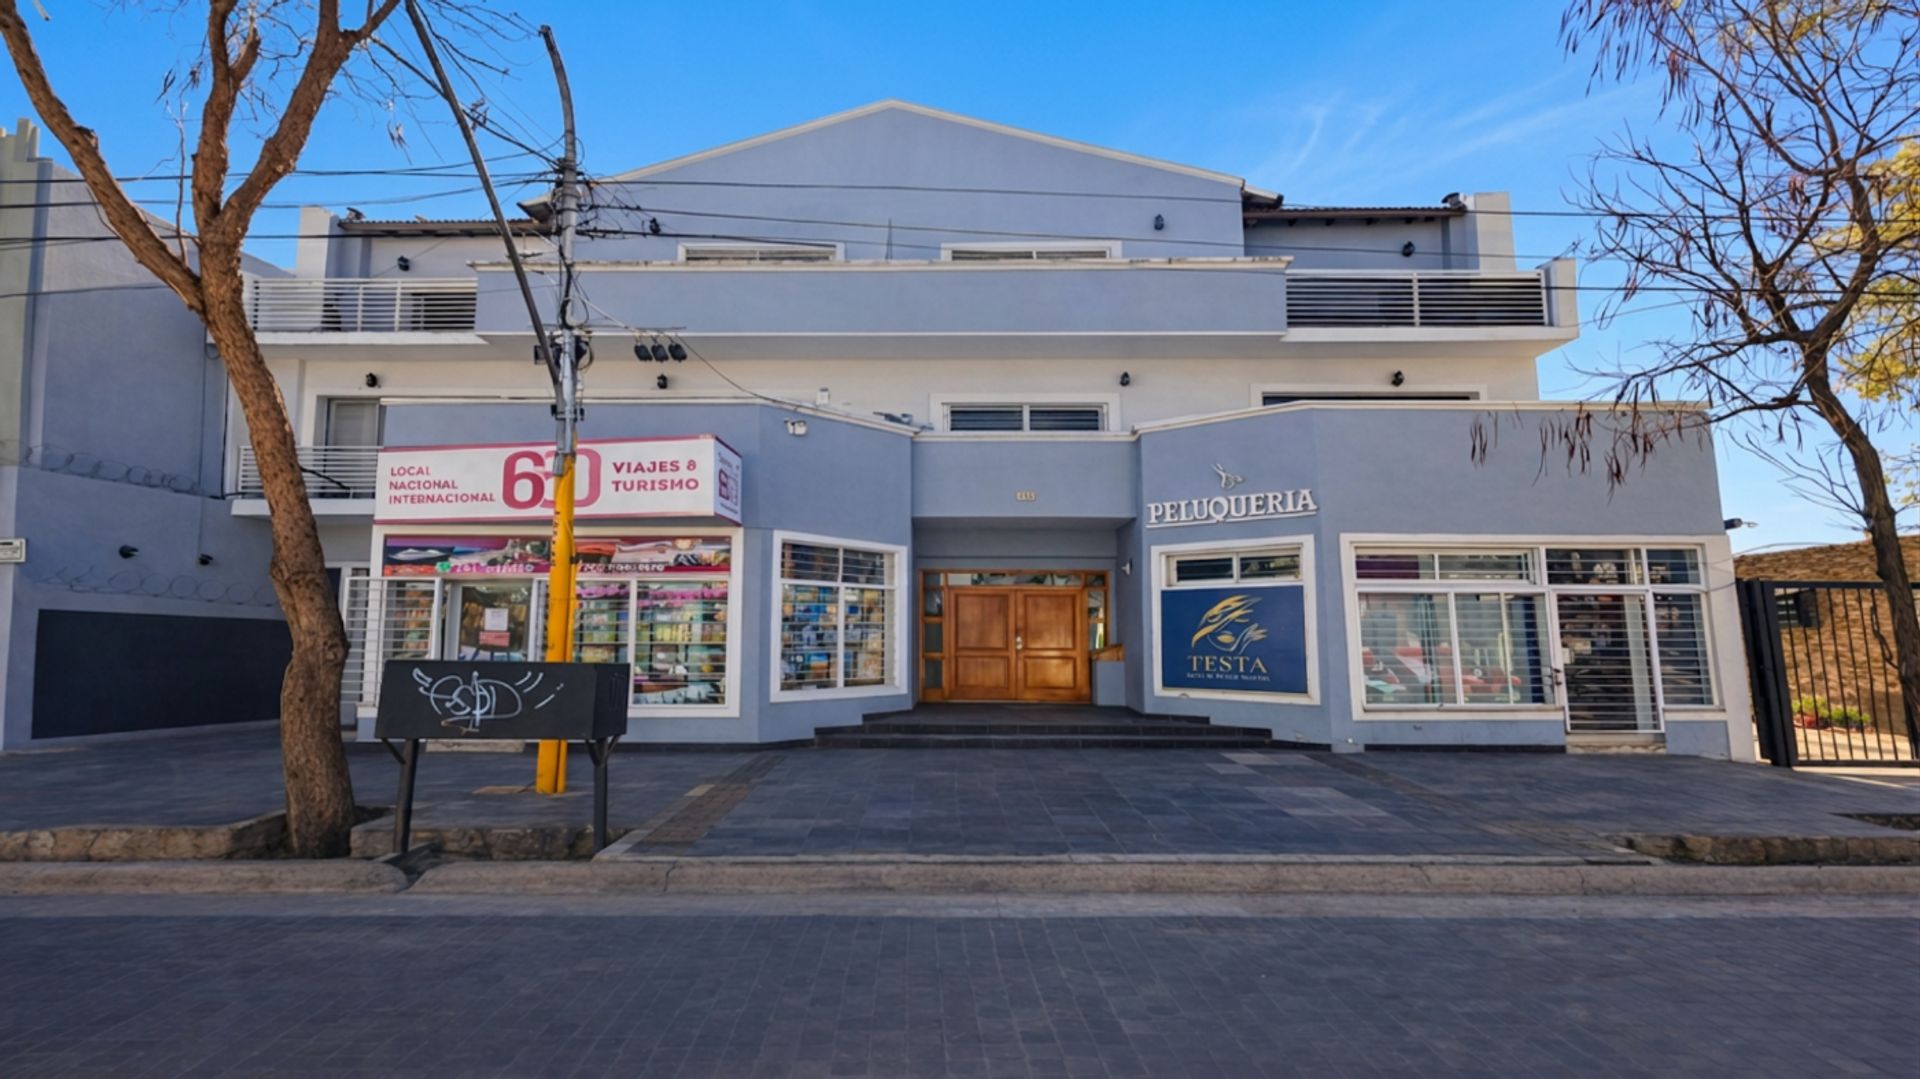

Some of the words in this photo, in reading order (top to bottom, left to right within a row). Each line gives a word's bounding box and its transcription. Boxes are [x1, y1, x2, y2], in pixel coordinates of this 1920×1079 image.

[390, 466, 431, 477] LOCAL
[612, 460, 680, 474] VIAJES
[389, 480, 458, 490] NACIONAL
[611, 478, 699, 492] TURISMO
[389, 493, 496, 504] INTERNACIONAL
[1147, 488, 1318, 523] PELUQUERIA
[1187, 655, 1268, 673] TESTA
